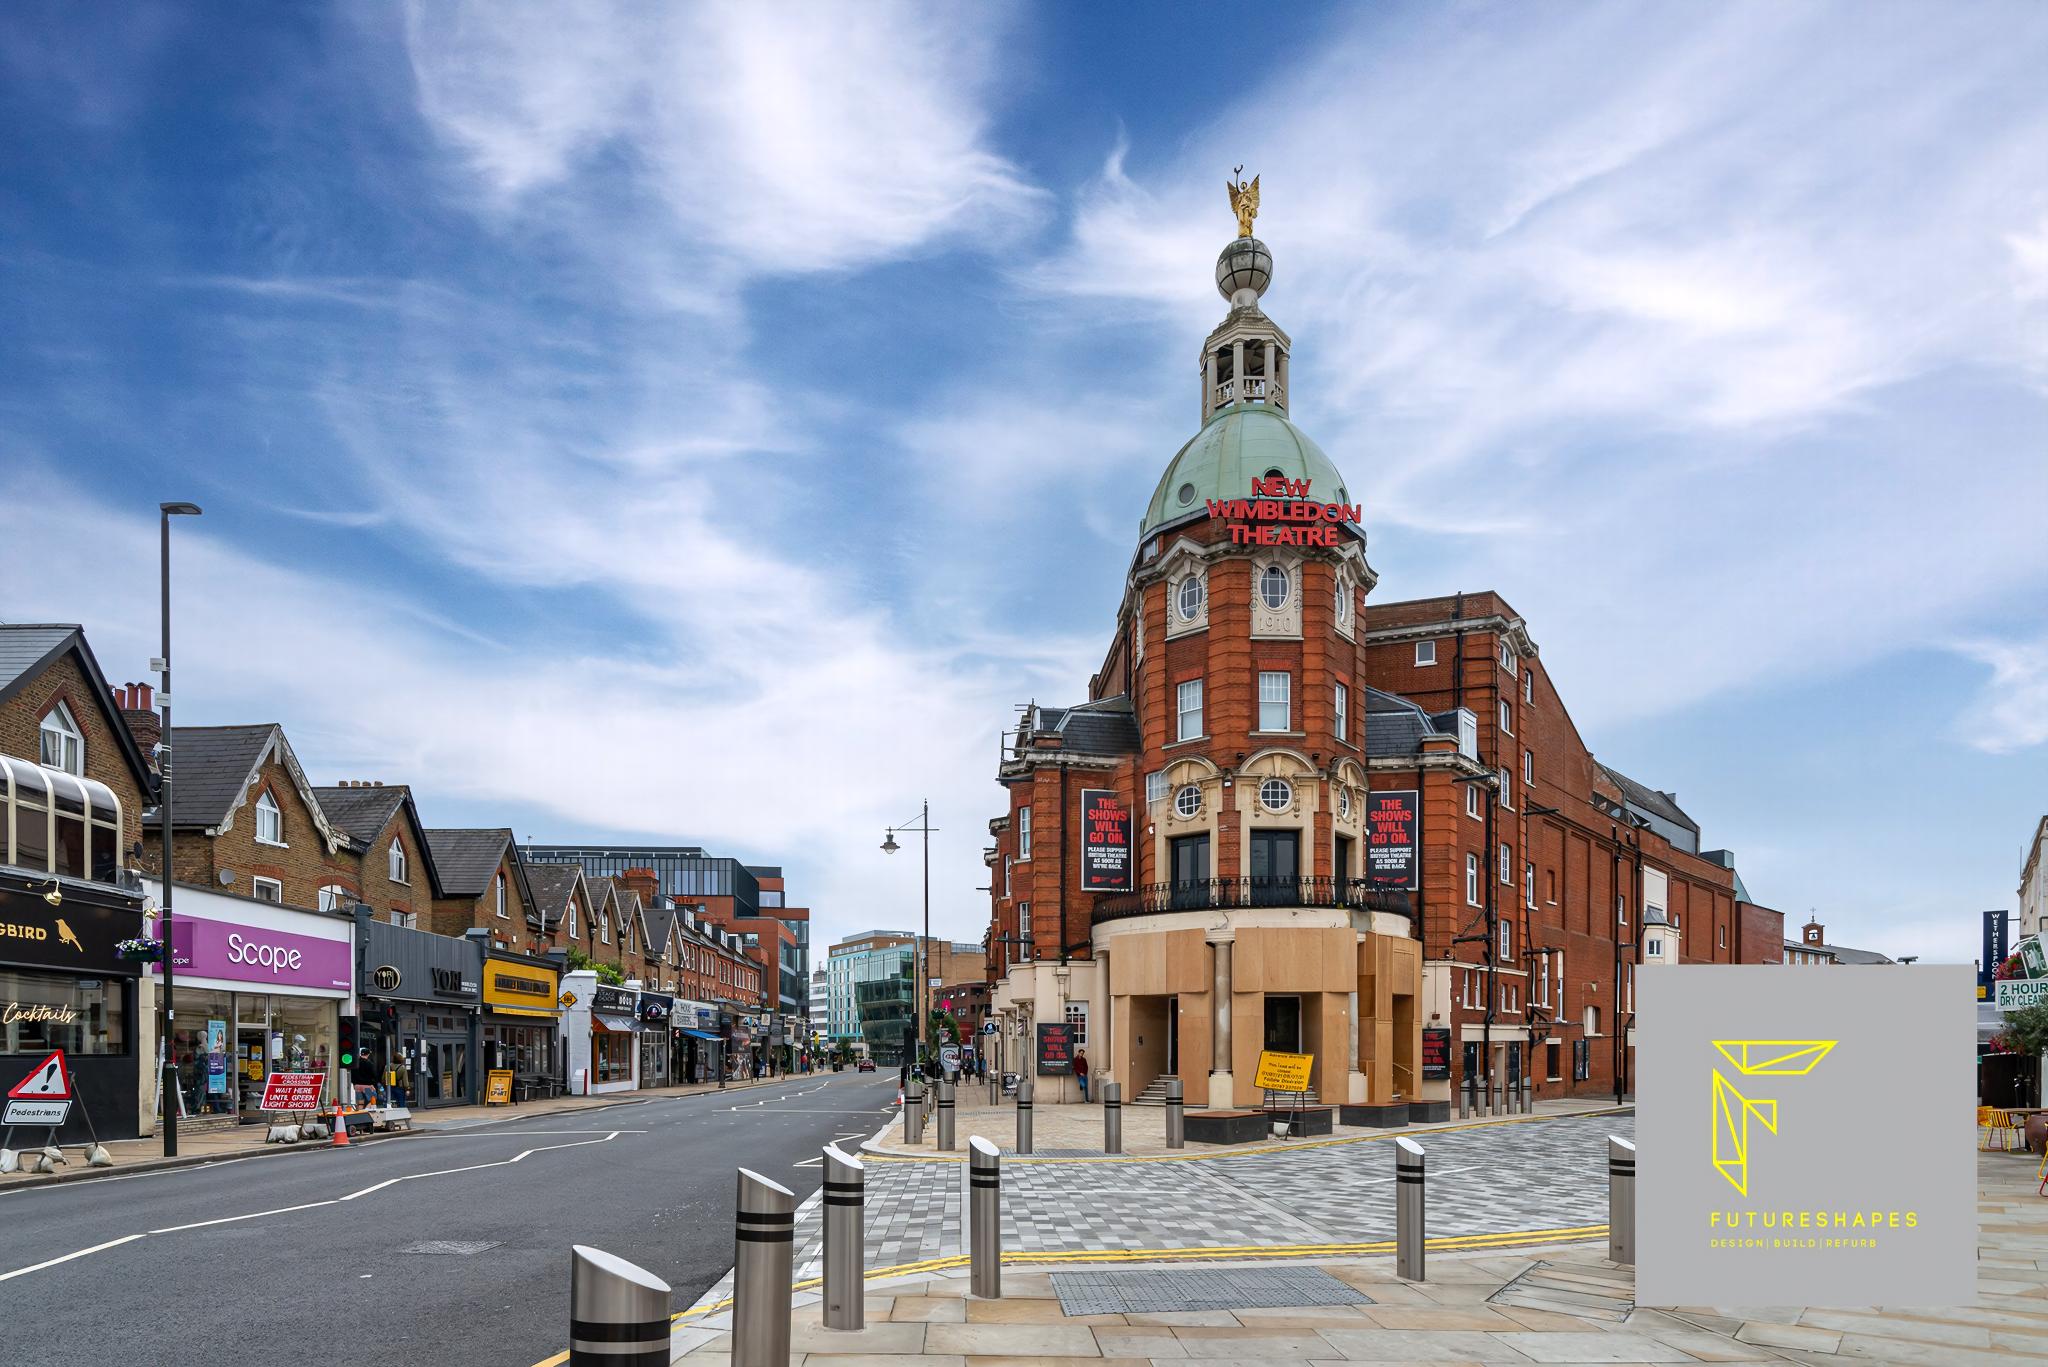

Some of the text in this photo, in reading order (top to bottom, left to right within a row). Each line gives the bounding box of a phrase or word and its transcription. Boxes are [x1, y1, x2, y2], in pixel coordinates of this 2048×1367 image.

[1251, 476, 1312, 498] NEW
[1206, 498, 1362, 524] WIMBLEDON
[1227, 524, 1339, 548] THEATRE
[1097, 798, 1118, 809] THE
[1380, 799, 1402, 810] THE
[1088, 809, 1128, 821] SHOWS
[1370, 810, 1412, 821] SHOWS
[1095, 820, 1121, 832] WILL
[1377, 821, 1405, 833] WILL
[1089, 832, 1125, 844] GO ON.
[1371, 833, 1410, 844] GO ON.
[228, 933, 302, 974] Scope
[2000, 985, 2007, 995] 2
[2000, 995, 2016, 1006] DRY
[3, 1002, 76, 1024] Cocktails
[10, 1108, 61, 1117] Pedestrians
